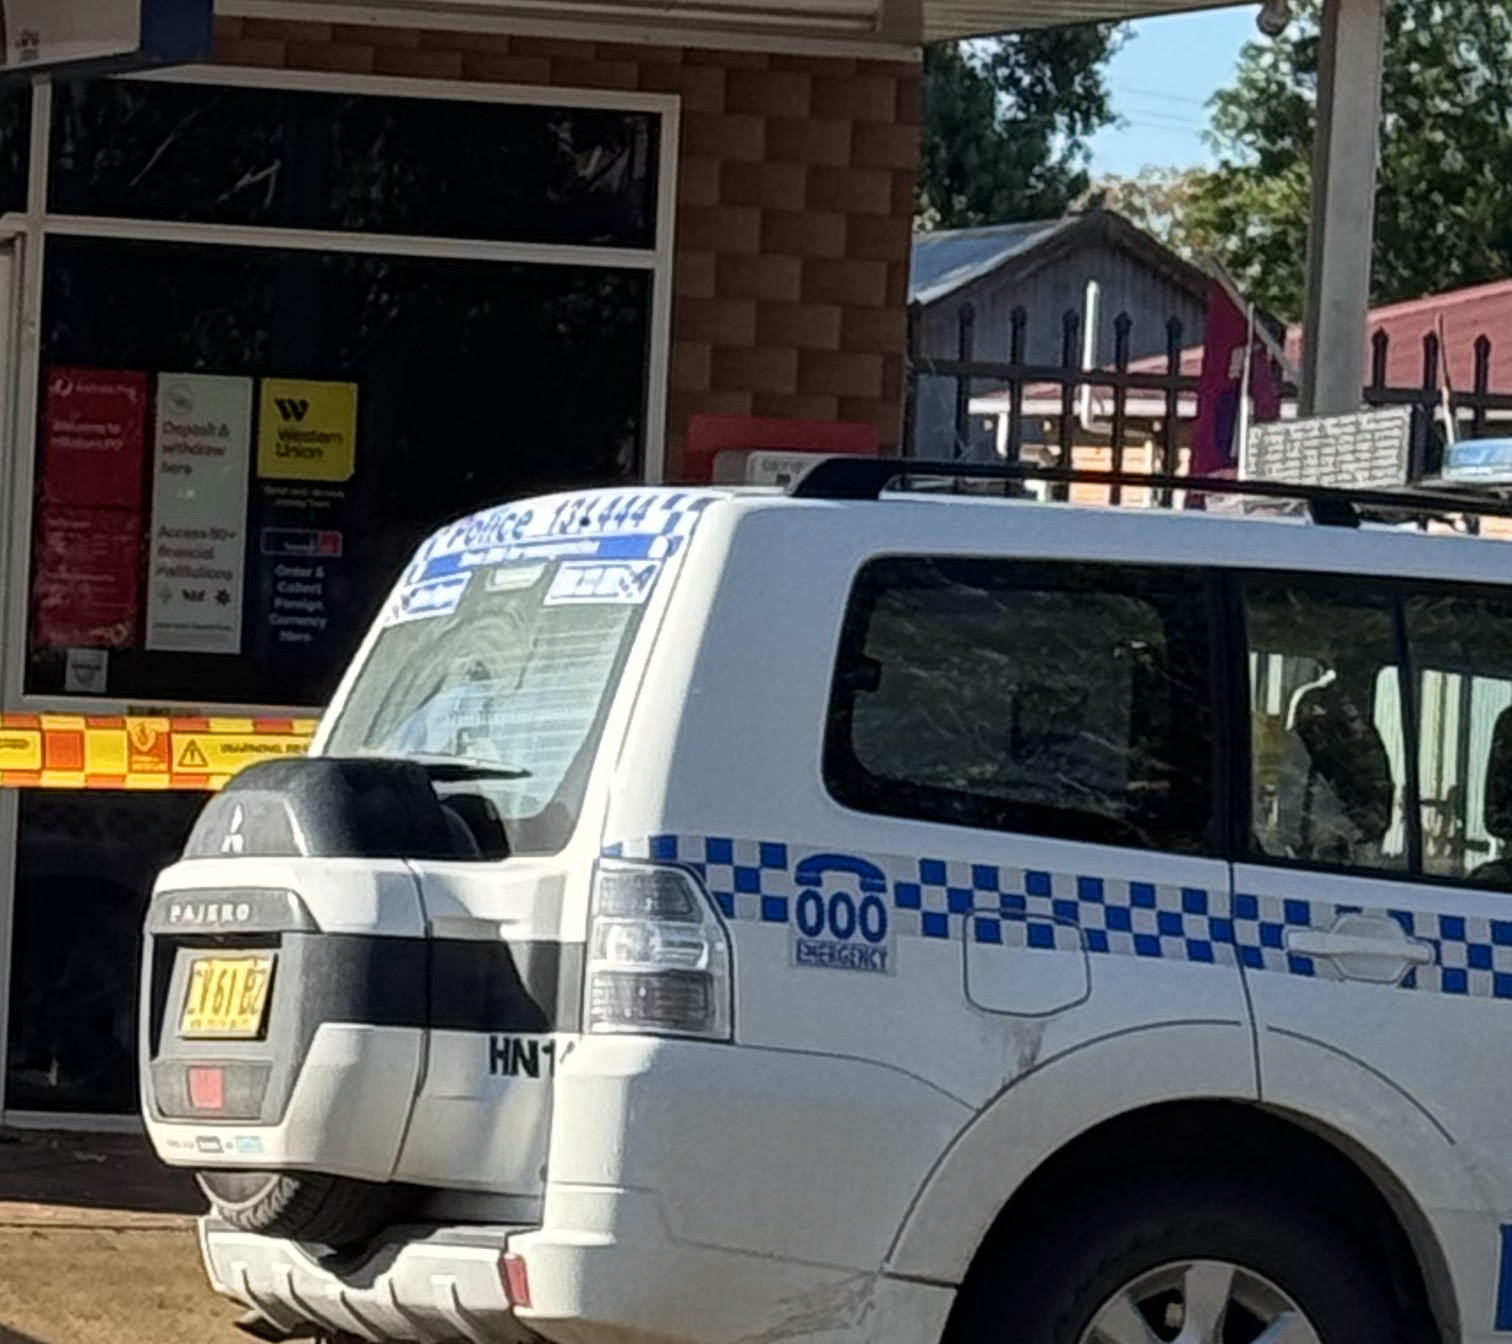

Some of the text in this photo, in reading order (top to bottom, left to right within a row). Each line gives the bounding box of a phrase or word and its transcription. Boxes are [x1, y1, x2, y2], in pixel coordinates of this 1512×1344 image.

[168, 903, 250, 924] PAJERO
[795, 888, 888, 943] 000
[795, 940, 888, 973] EMERGENCY
